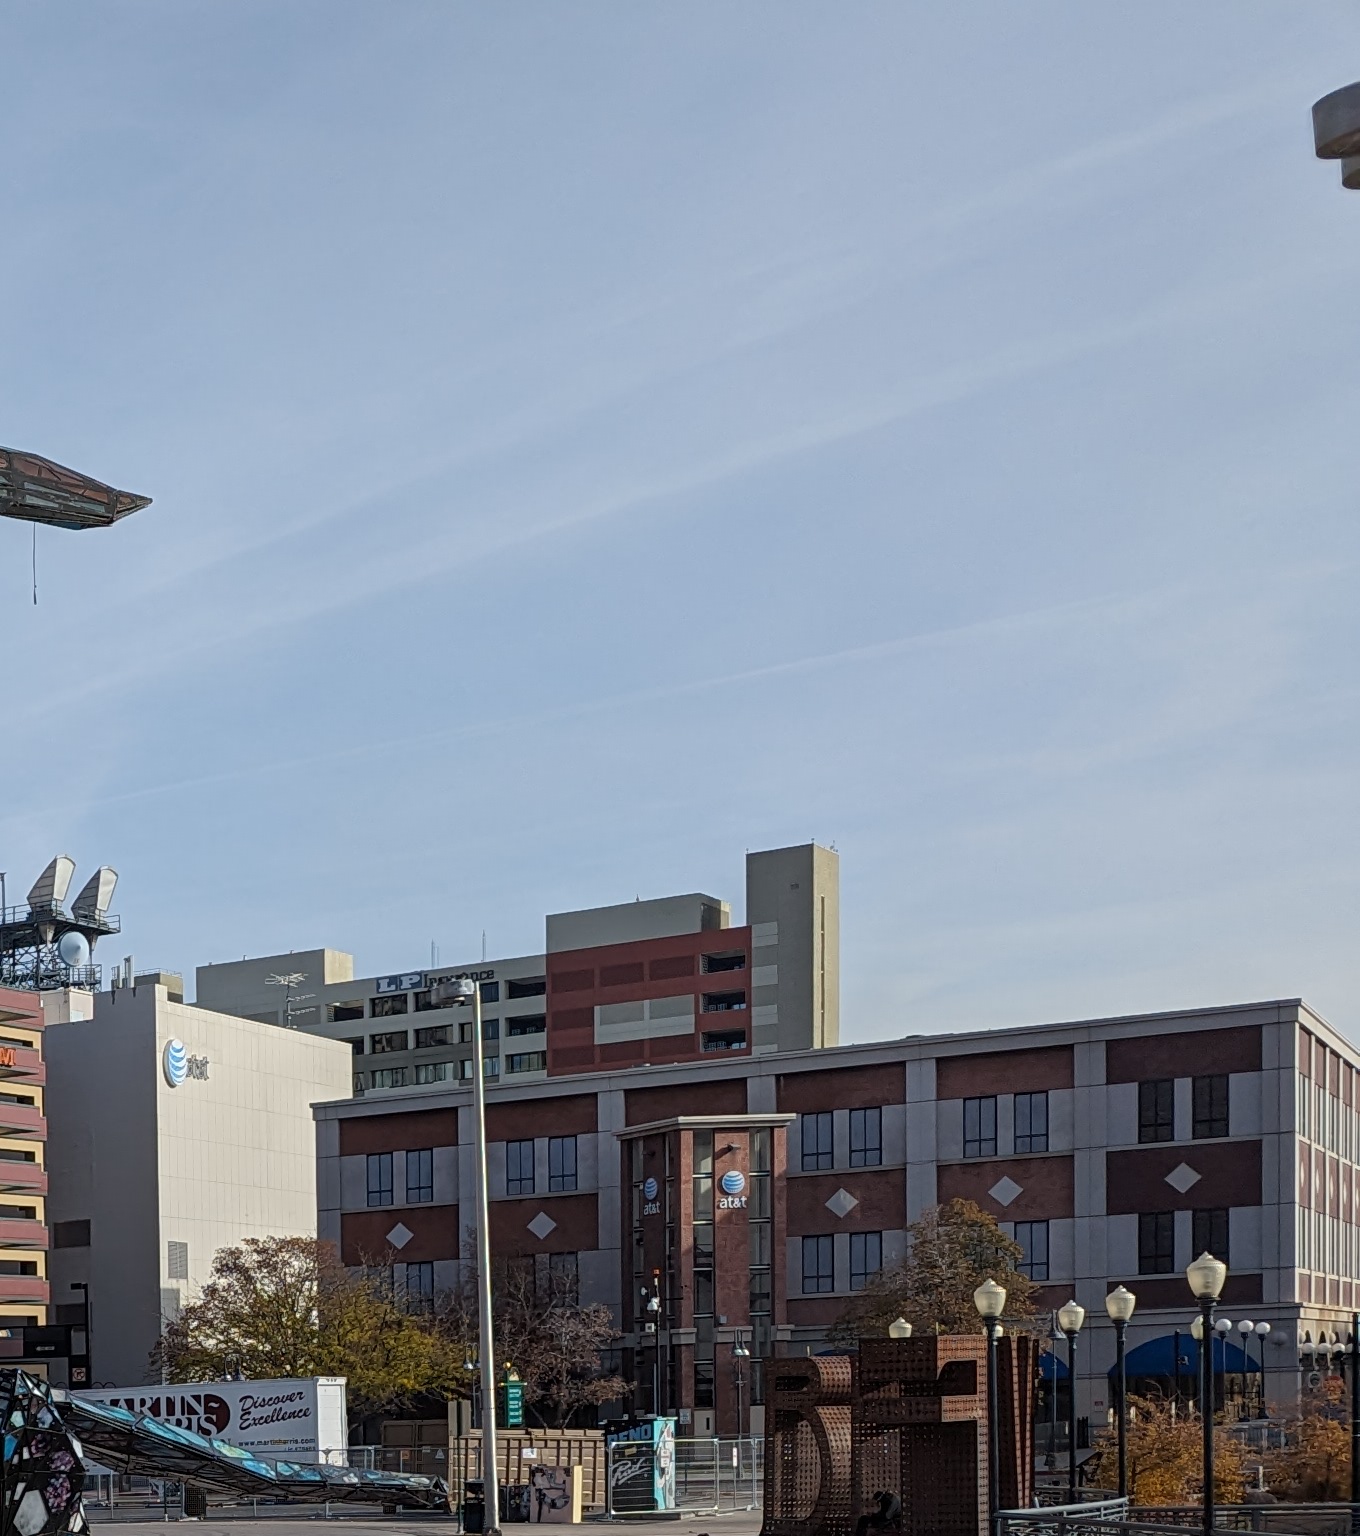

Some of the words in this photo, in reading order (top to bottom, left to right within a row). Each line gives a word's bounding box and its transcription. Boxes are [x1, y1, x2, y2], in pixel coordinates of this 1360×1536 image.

[643, 1201, 661, 1216] at&t
[719, 1195, 748, 1209] at&t
[238, 1391, 306, 1412] Discover
[238, 1407, 312, 1431] Excellence
